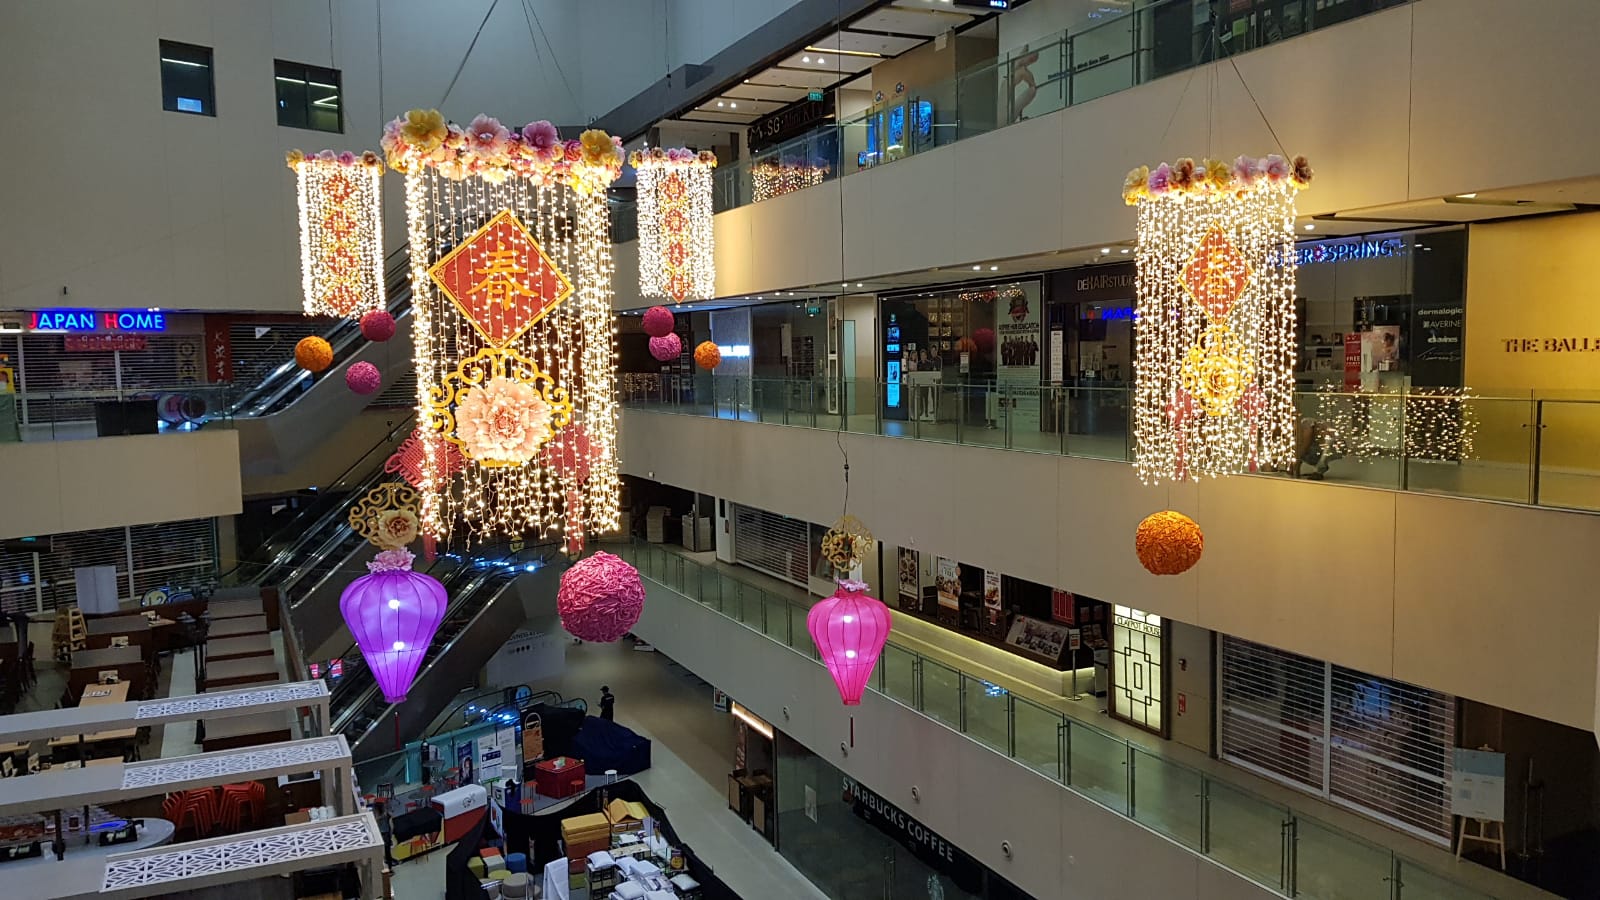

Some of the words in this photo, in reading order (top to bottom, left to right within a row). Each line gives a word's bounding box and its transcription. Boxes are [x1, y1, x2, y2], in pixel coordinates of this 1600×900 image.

[1324, 240, 1395, 262] SPRING
[466, 240, 539, 311] 春
[28, 312, 94, 329] JAPAN
[104, 312, 163, 329] HOME
[1501, 338, 1538, 352] THE
[1117, 617, 1141, 630] CLAYPOT
[843, 777, 904, 829] STARBUCKS
[907, 821, 953, 862] COFFEE
